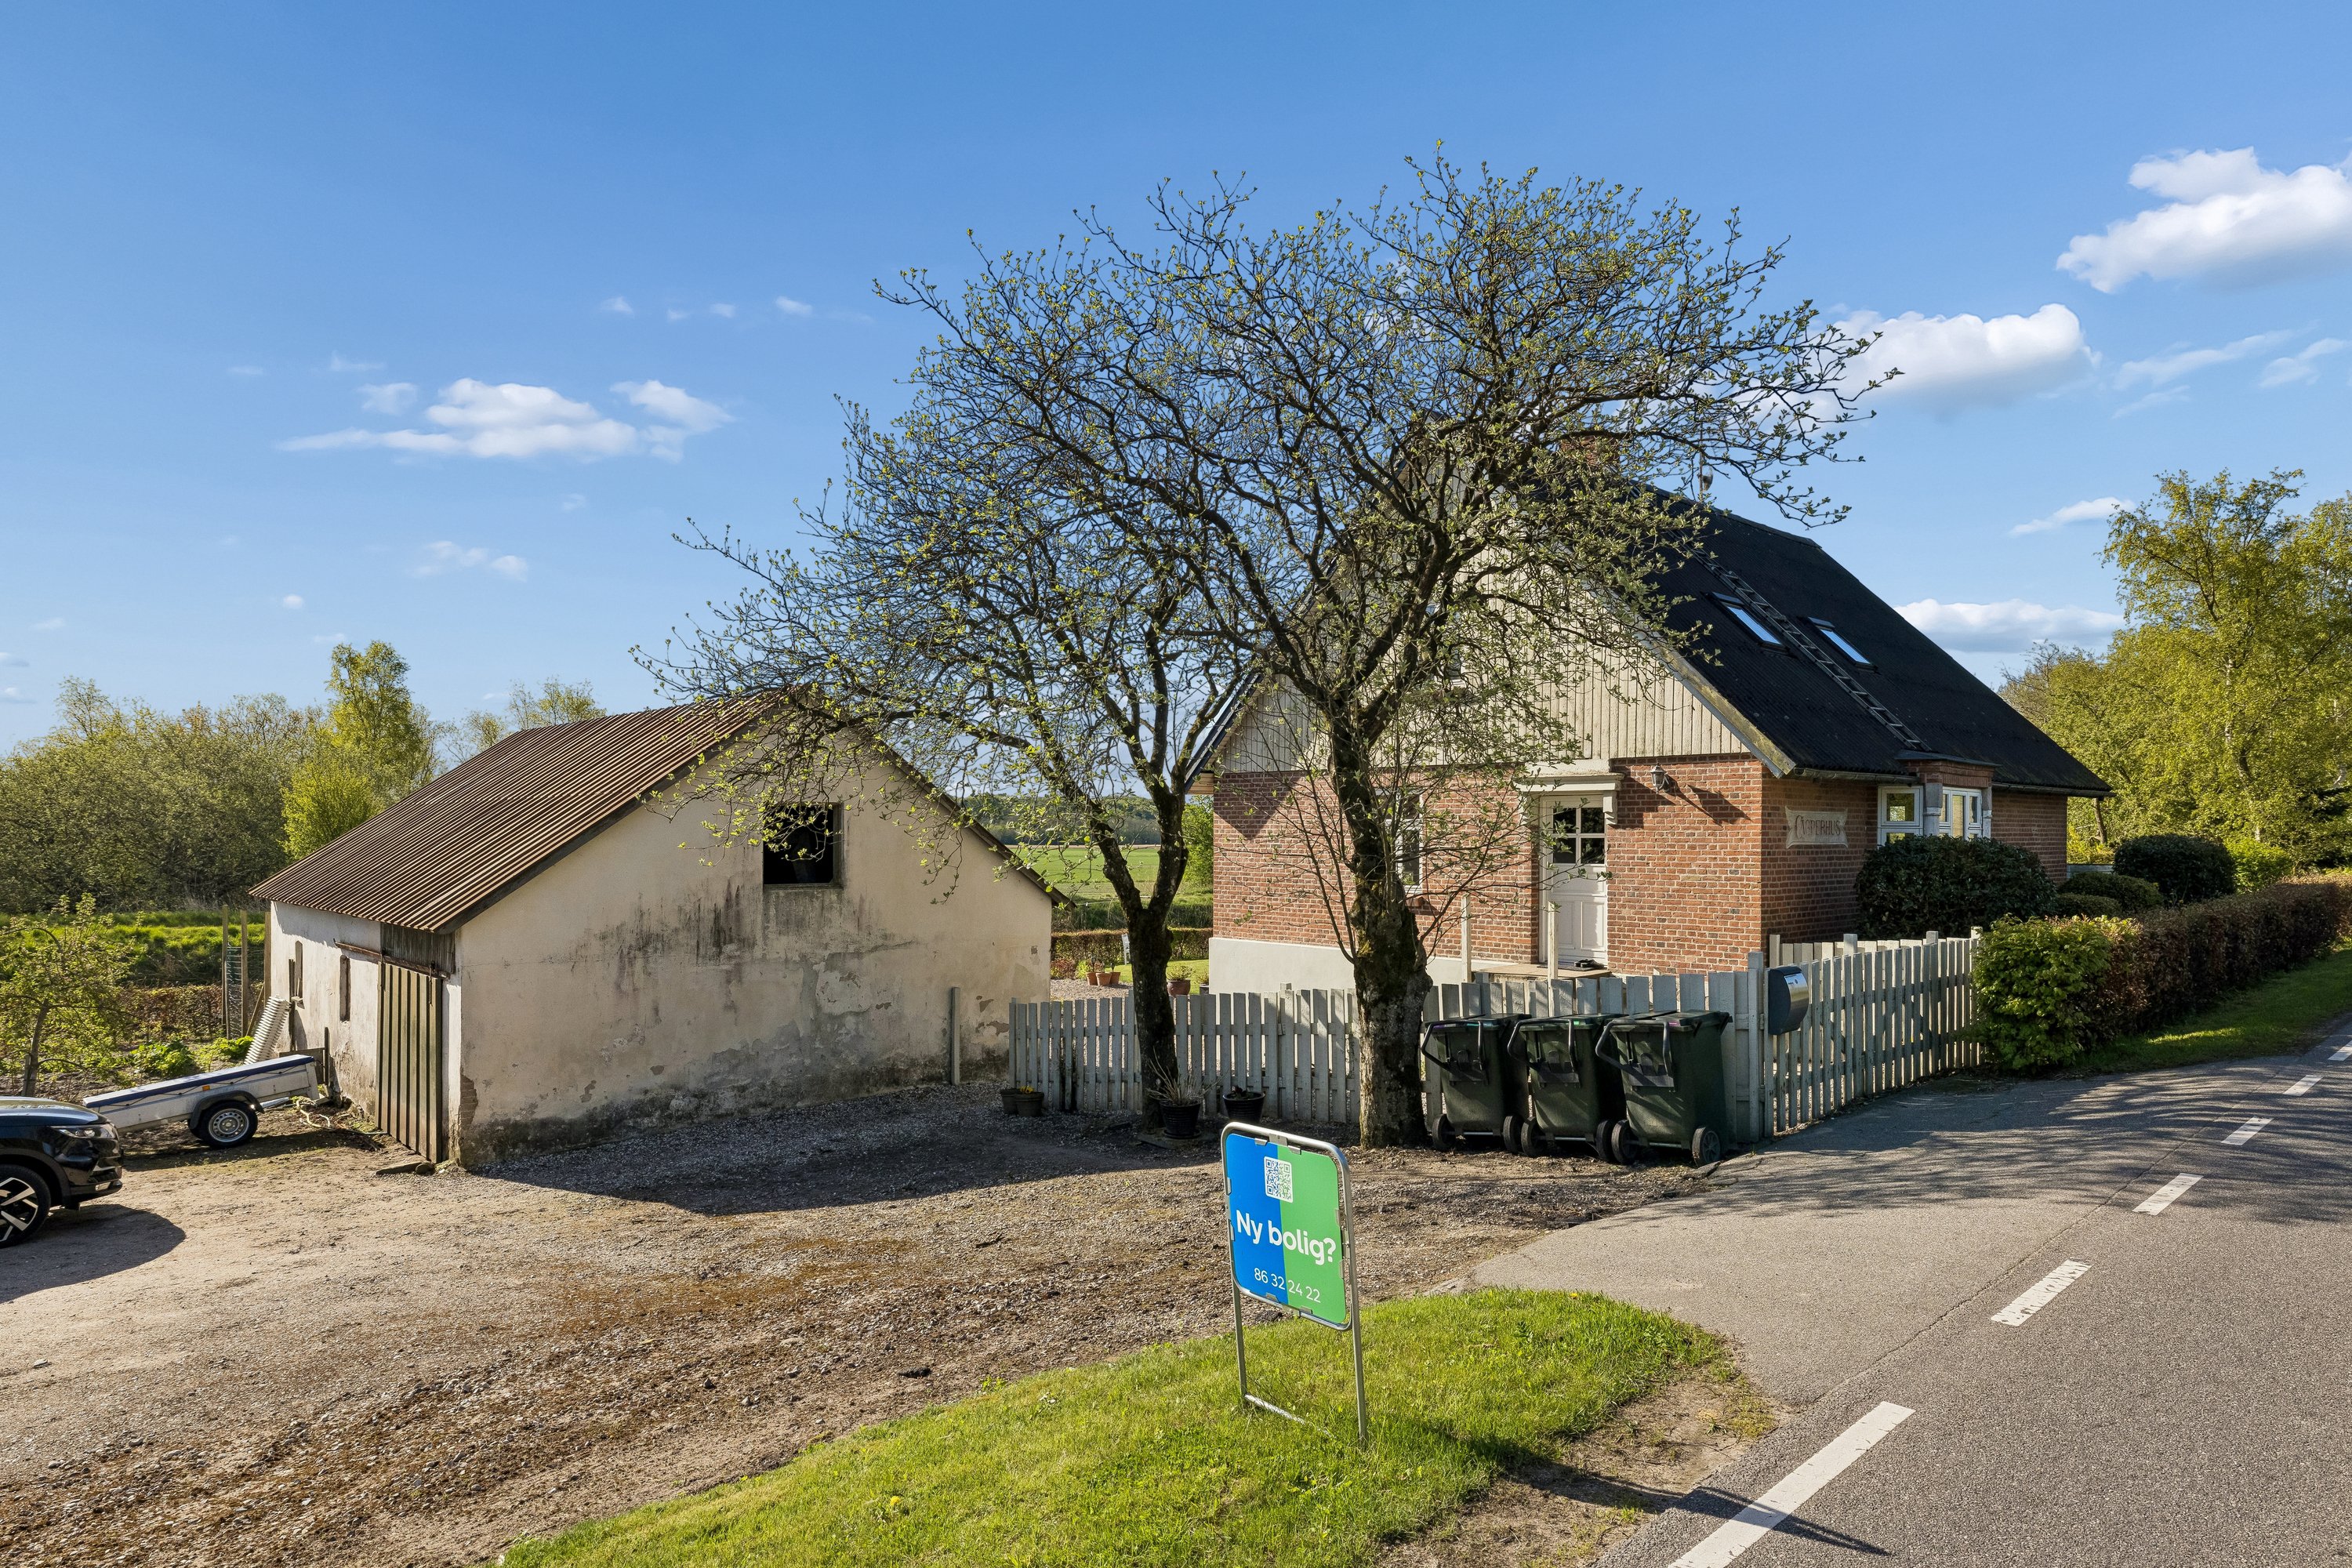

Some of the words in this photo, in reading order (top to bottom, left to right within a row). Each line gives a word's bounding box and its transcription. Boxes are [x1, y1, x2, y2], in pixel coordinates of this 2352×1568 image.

[1236, 1210, 1262, 1244] Ny
[1269, 1220, 1336, 1265] bolig?
[1254, 1268, 1268, 1283] 86
[1271, 1273, 1286, 1290] 32
[1288, 1279, 1303, 1297] 24
[1306, 1287, 1321, 1303] 22
